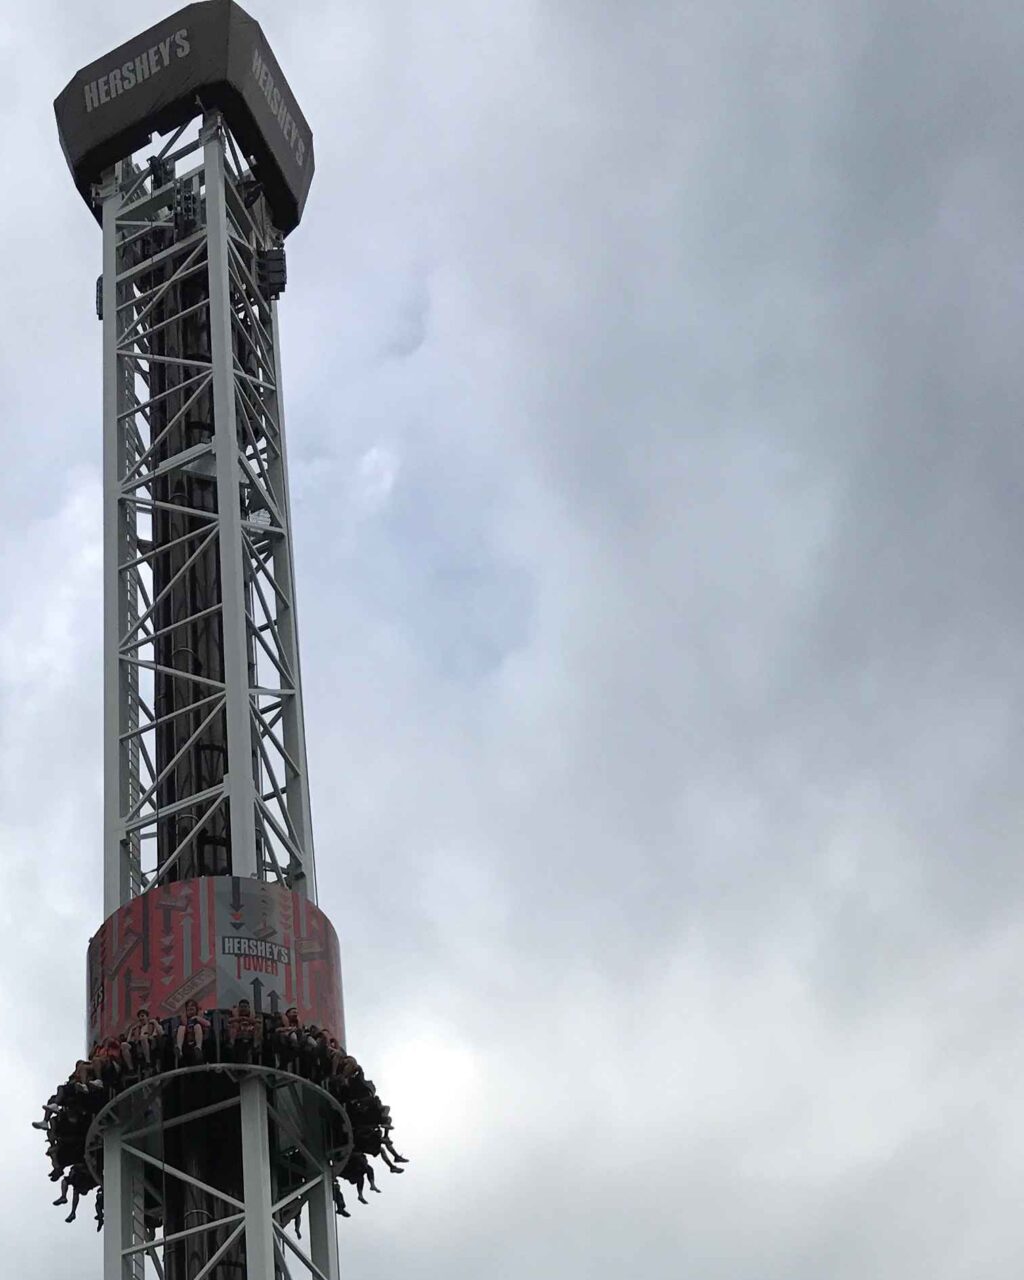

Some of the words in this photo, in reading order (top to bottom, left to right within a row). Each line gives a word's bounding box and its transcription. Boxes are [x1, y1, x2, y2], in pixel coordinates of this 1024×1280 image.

[83, 28, 191, 112] HERSHEY'S
[224, 938, 289, 963] HERSHEY'S
[235, 953, 279, 980] TOWER
